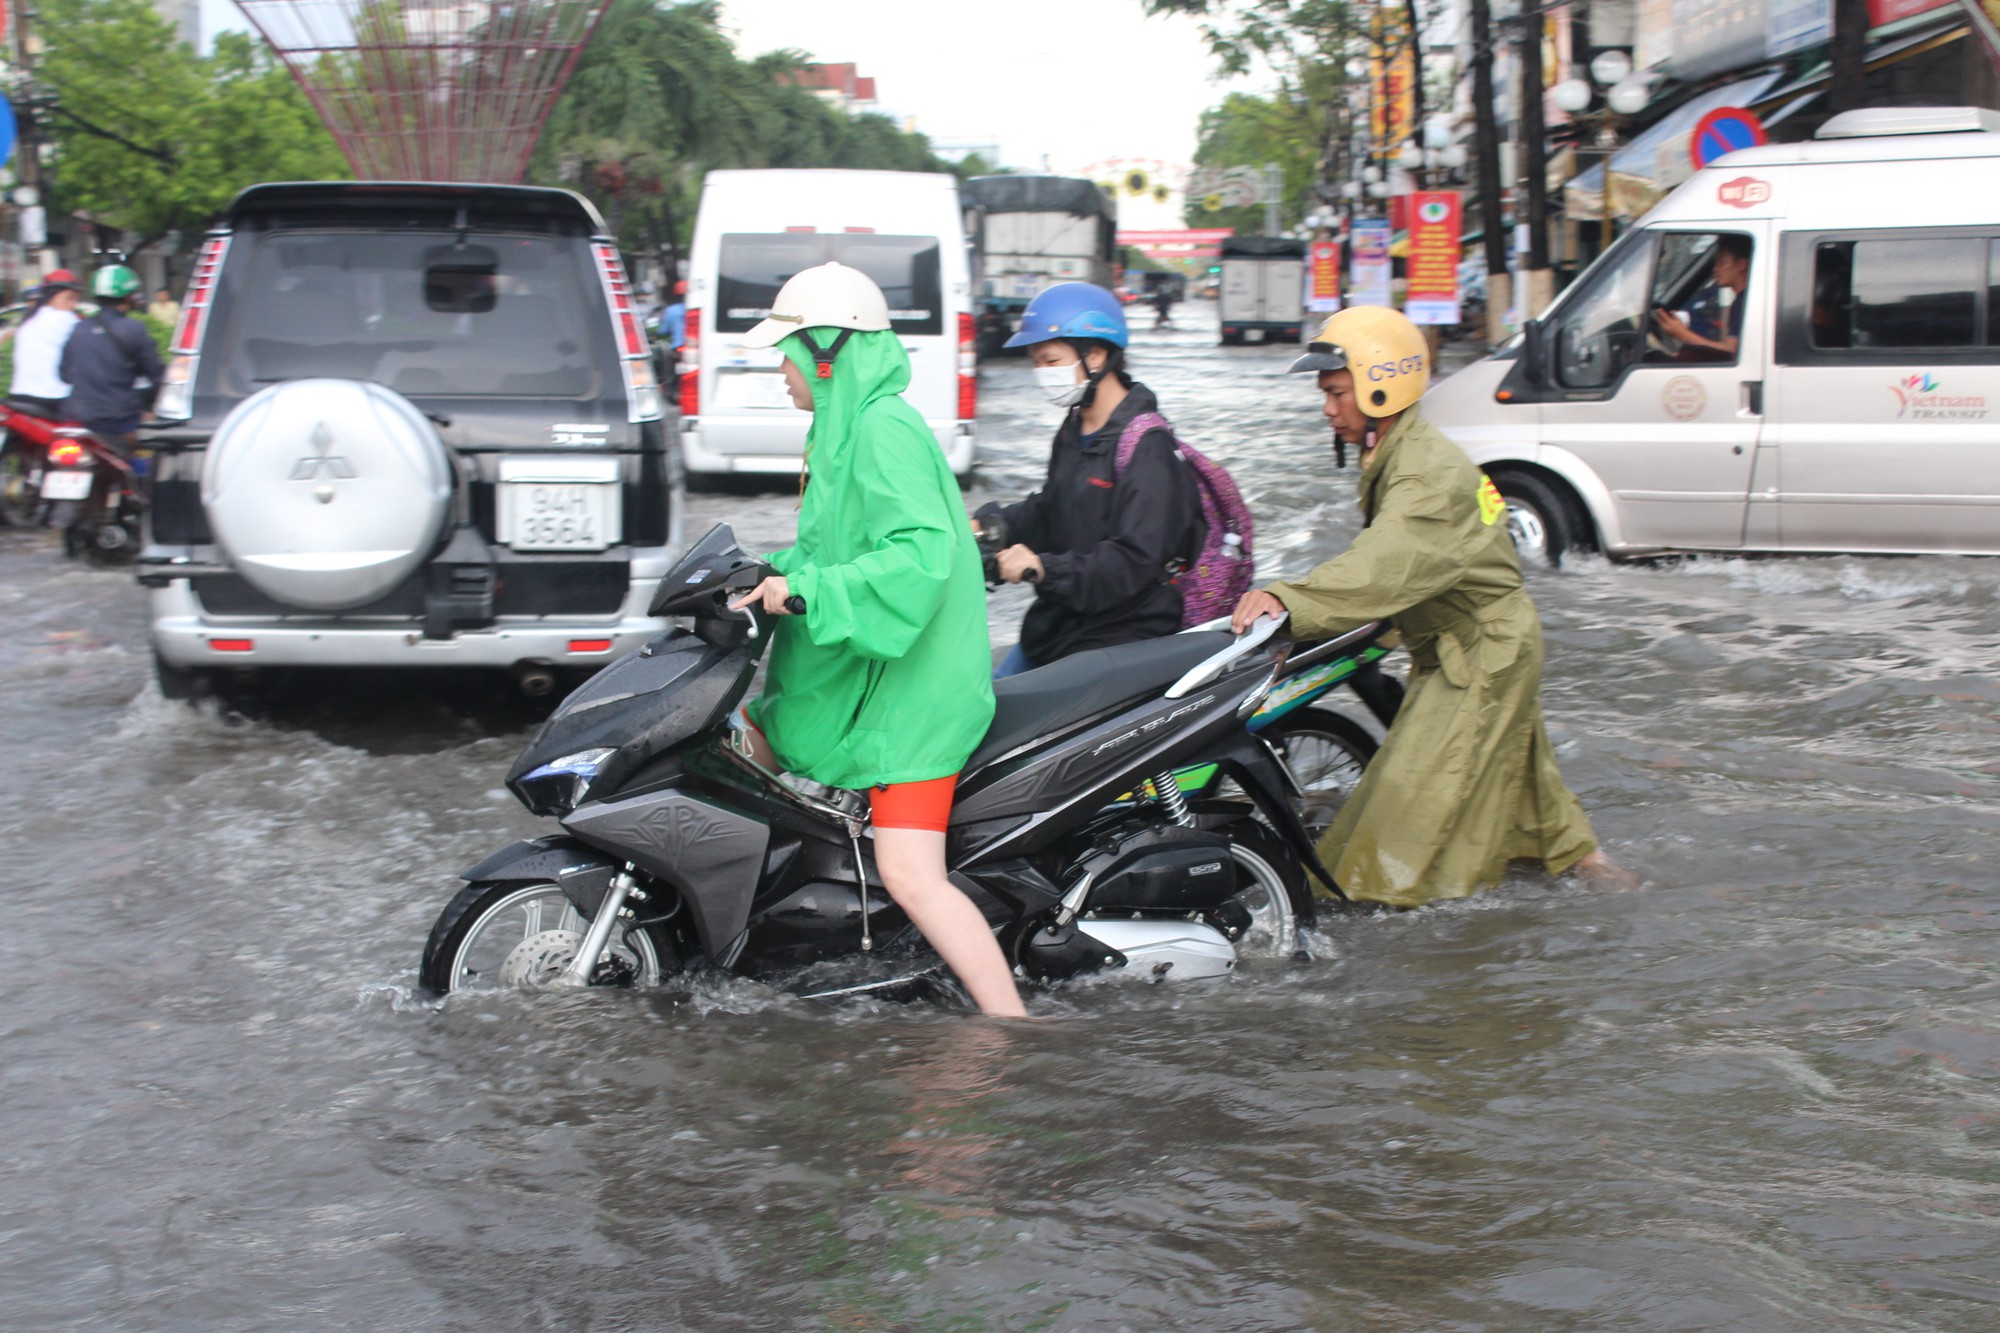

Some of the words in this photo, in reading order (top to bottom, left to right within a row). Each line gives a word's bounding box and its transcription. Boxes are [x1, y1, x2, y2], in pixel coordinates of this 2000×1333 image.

[1367, 355, 1423, 382] CSGT
[1888, 385, 1985, 418] Vietnam
[1911, 409, 1989, 419] TRANSIT
[522, 517, 594, 544] 3564
